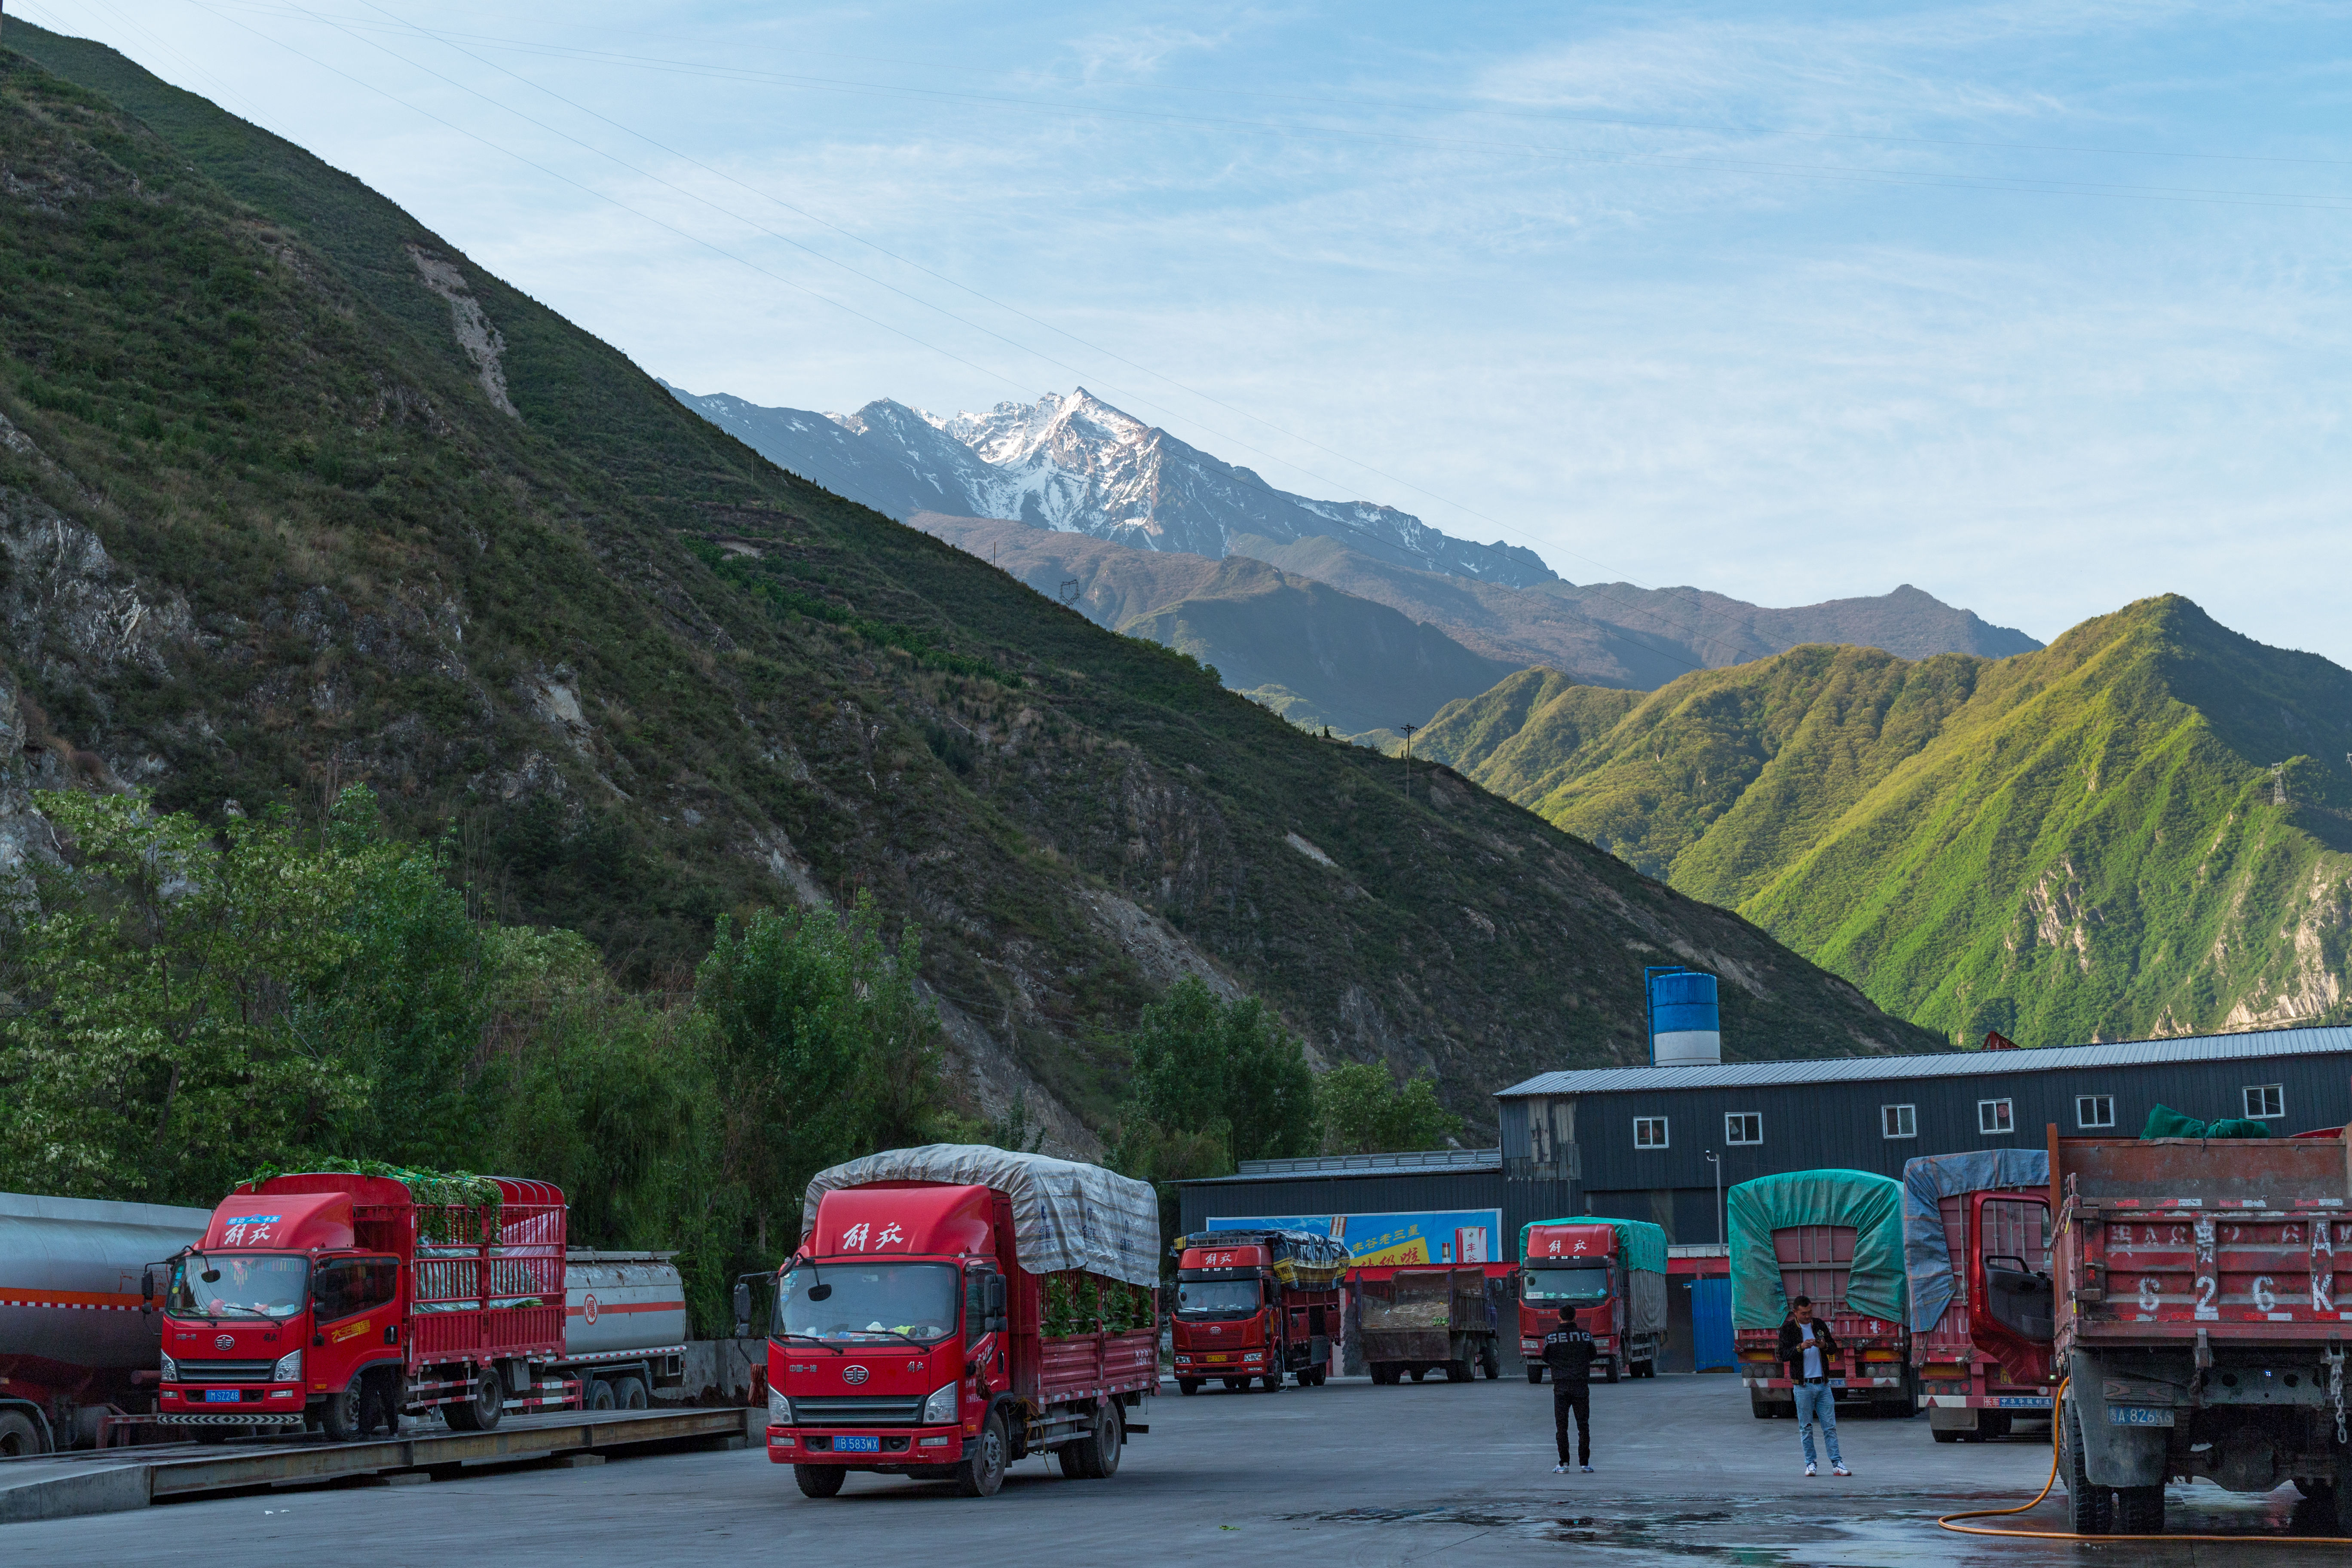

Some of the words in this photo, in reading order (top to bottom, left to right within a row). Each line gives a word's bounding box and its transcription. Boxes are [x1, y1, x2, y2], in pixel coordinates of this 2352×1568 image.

[224, 1223, 271, 1246] 解放
[843, 1222, 904, 1251] 解放
[1352, 1224, 1420, 1253] 丰谷老三星
[1549, 1239, 1587, 1253] 解放
[1205, 1253, 1232, 1265] 解放
[587, 1300, 596, 1319] 爆
